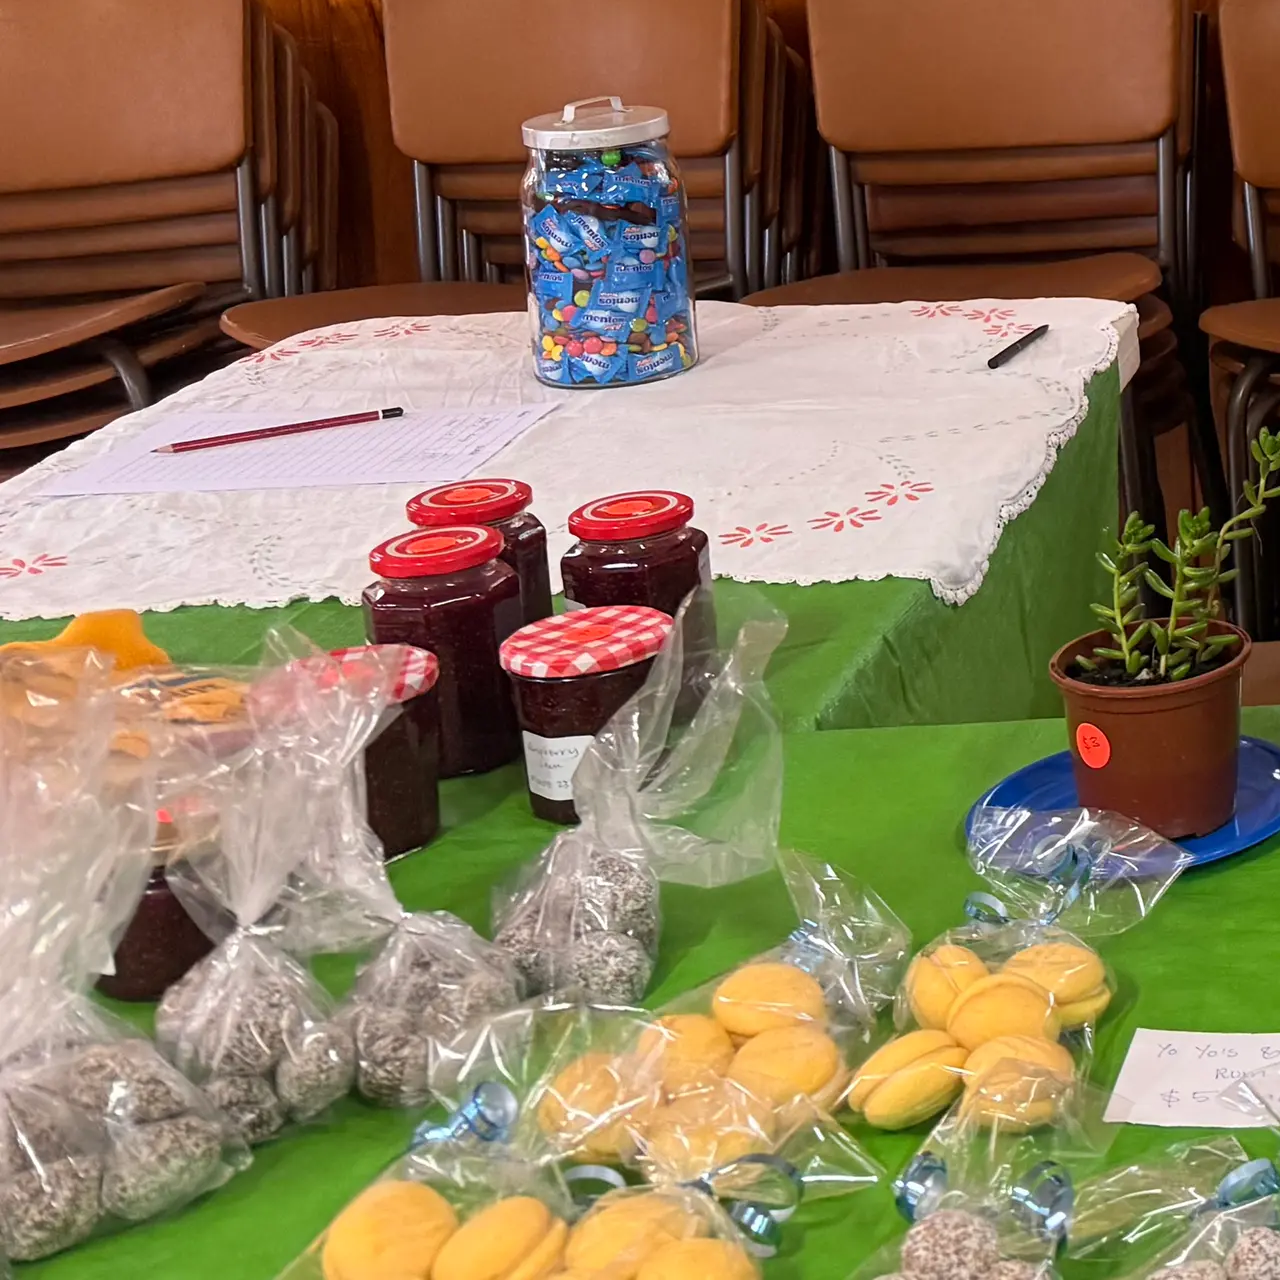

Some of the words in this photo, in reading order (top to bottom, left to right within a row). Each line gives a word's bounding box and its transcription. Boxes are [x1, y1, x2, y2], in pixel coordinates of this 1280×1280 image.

[574, 216, 607, 249] mentos
[583, 314, 626, 323] mentos
[637, 353, 674, 374] mentos
[1158, 1043, 1178, 1058] Yo
[1195, 1044, 1238, 1059] Yo's
